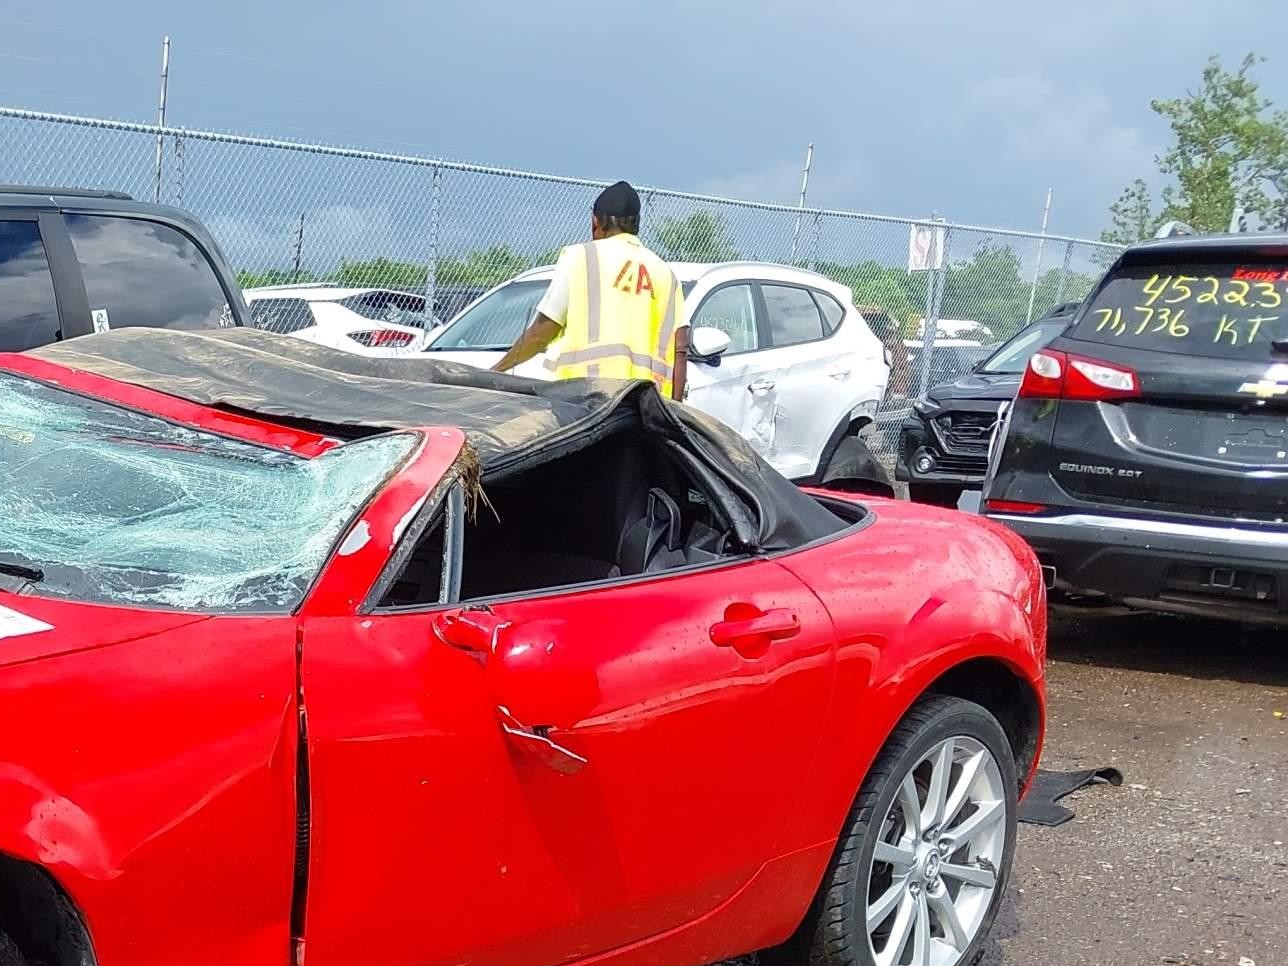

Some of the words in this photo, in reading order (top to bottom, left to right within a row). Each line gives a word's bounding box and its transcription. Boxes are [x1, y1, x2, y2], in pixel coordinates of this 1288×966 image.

[1232, 268, 1280, 283] Long
[1142, 274, 1281, 308] 45223
[1094, 306, 1189, 337] 71,736
[1059, 462, 1115, 476] EQUINOX
